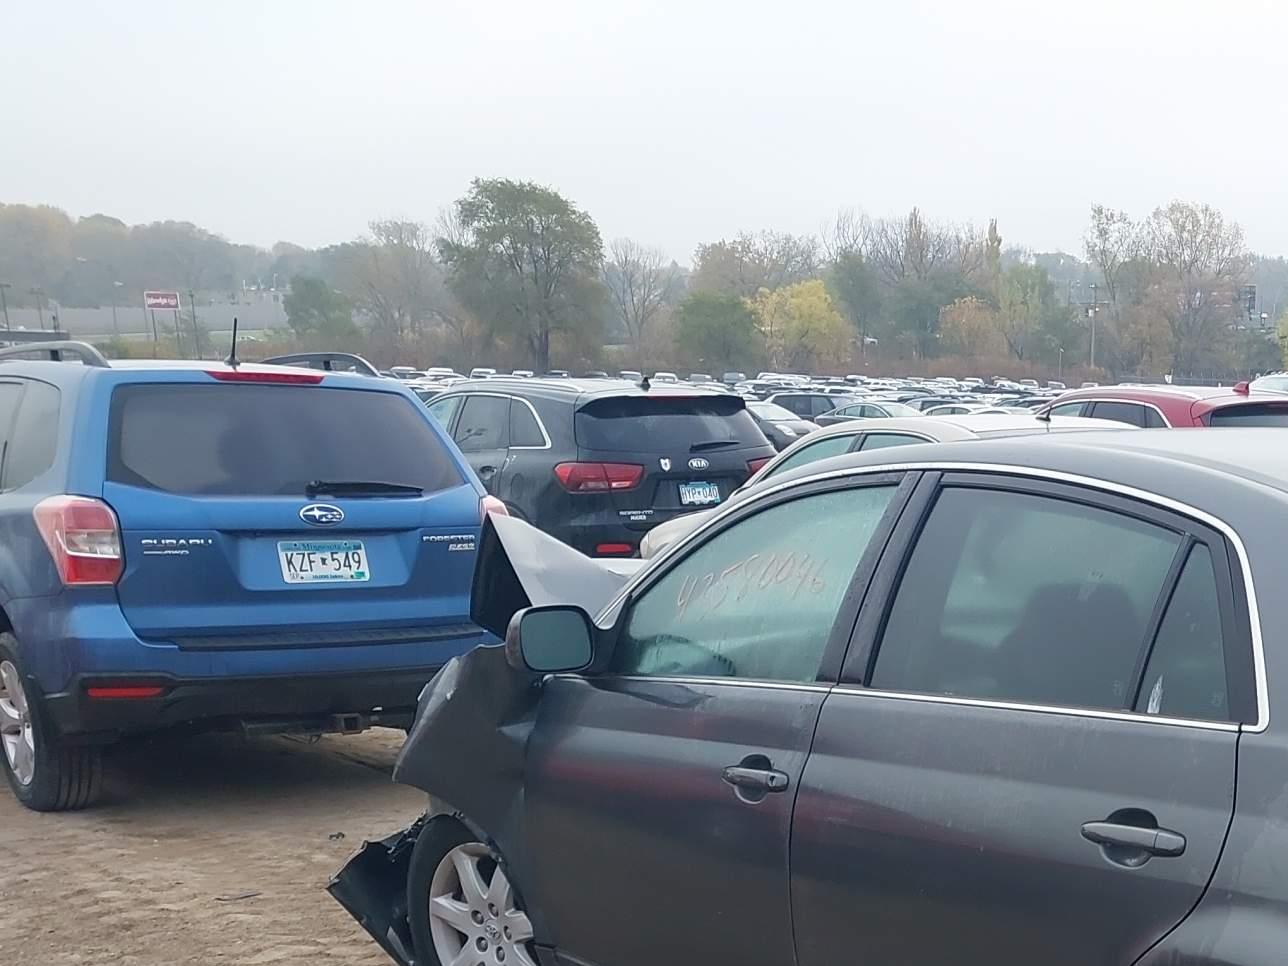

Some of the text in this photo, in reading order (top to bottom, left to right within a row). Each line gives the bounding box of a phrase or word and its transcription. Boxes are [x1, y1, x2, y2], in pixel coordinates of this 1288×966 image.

[422, 534, 476, 542] FORESTER
[141, 539, 213, 547] SUBARU
[285, 551, 362, 572] KZF 549
